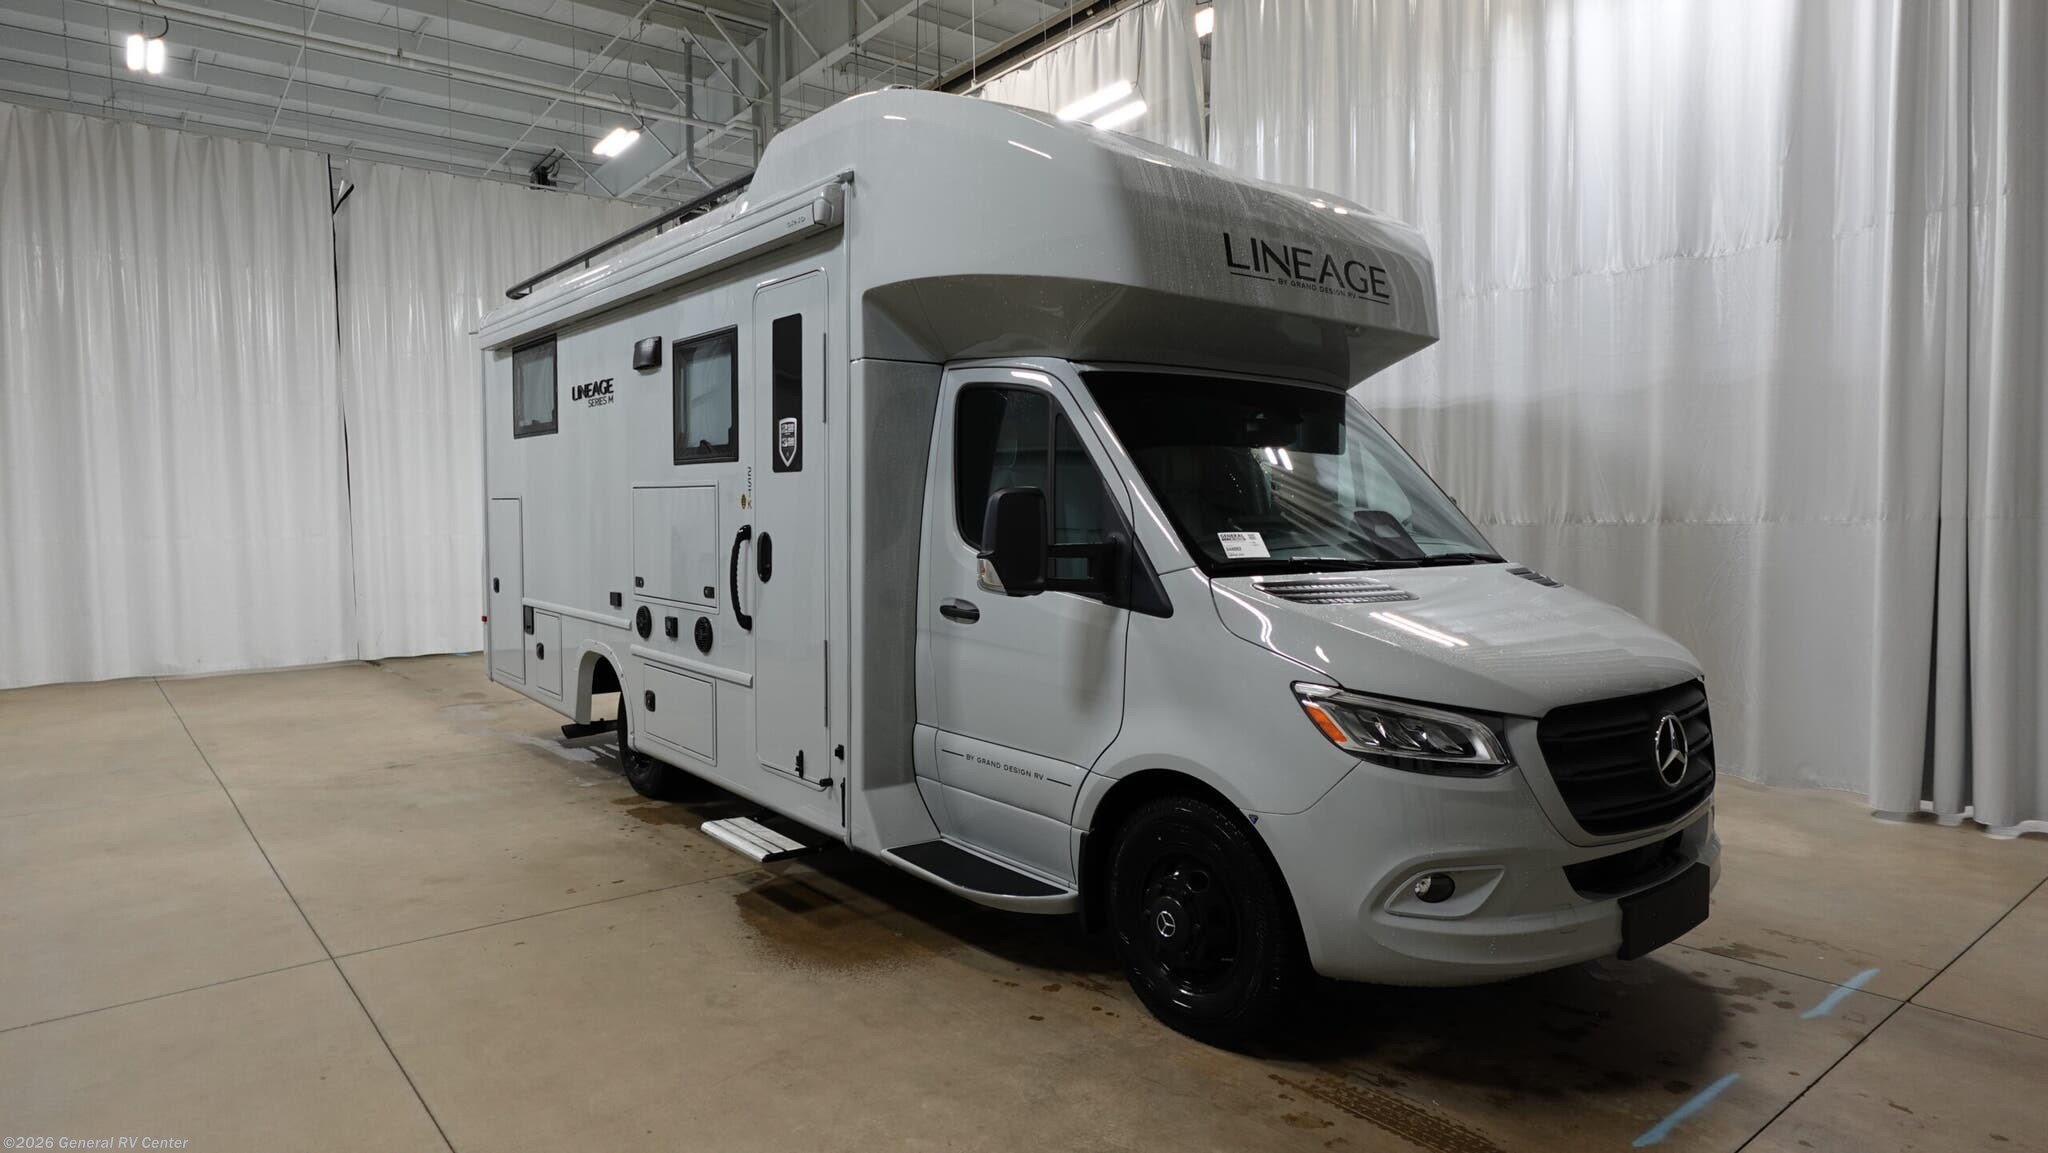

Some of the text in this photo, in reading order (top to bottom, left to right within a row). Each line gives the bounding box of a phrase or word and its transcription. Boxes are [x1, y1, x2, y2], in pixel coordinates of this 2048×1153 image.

[1223, 232, 1390, 299] LINEAGE
[1278, 278, 1288, 286] BY
[1290, 280, 1317, 291] GRAND
[1319, 286, 1346, 297] DESIGN
[572, 378, 614, 401] LINEAGE
[587, 395, 614, 408] SERIES M
[965, 753, 1044, 781] BY GRAND DESIGN RV
